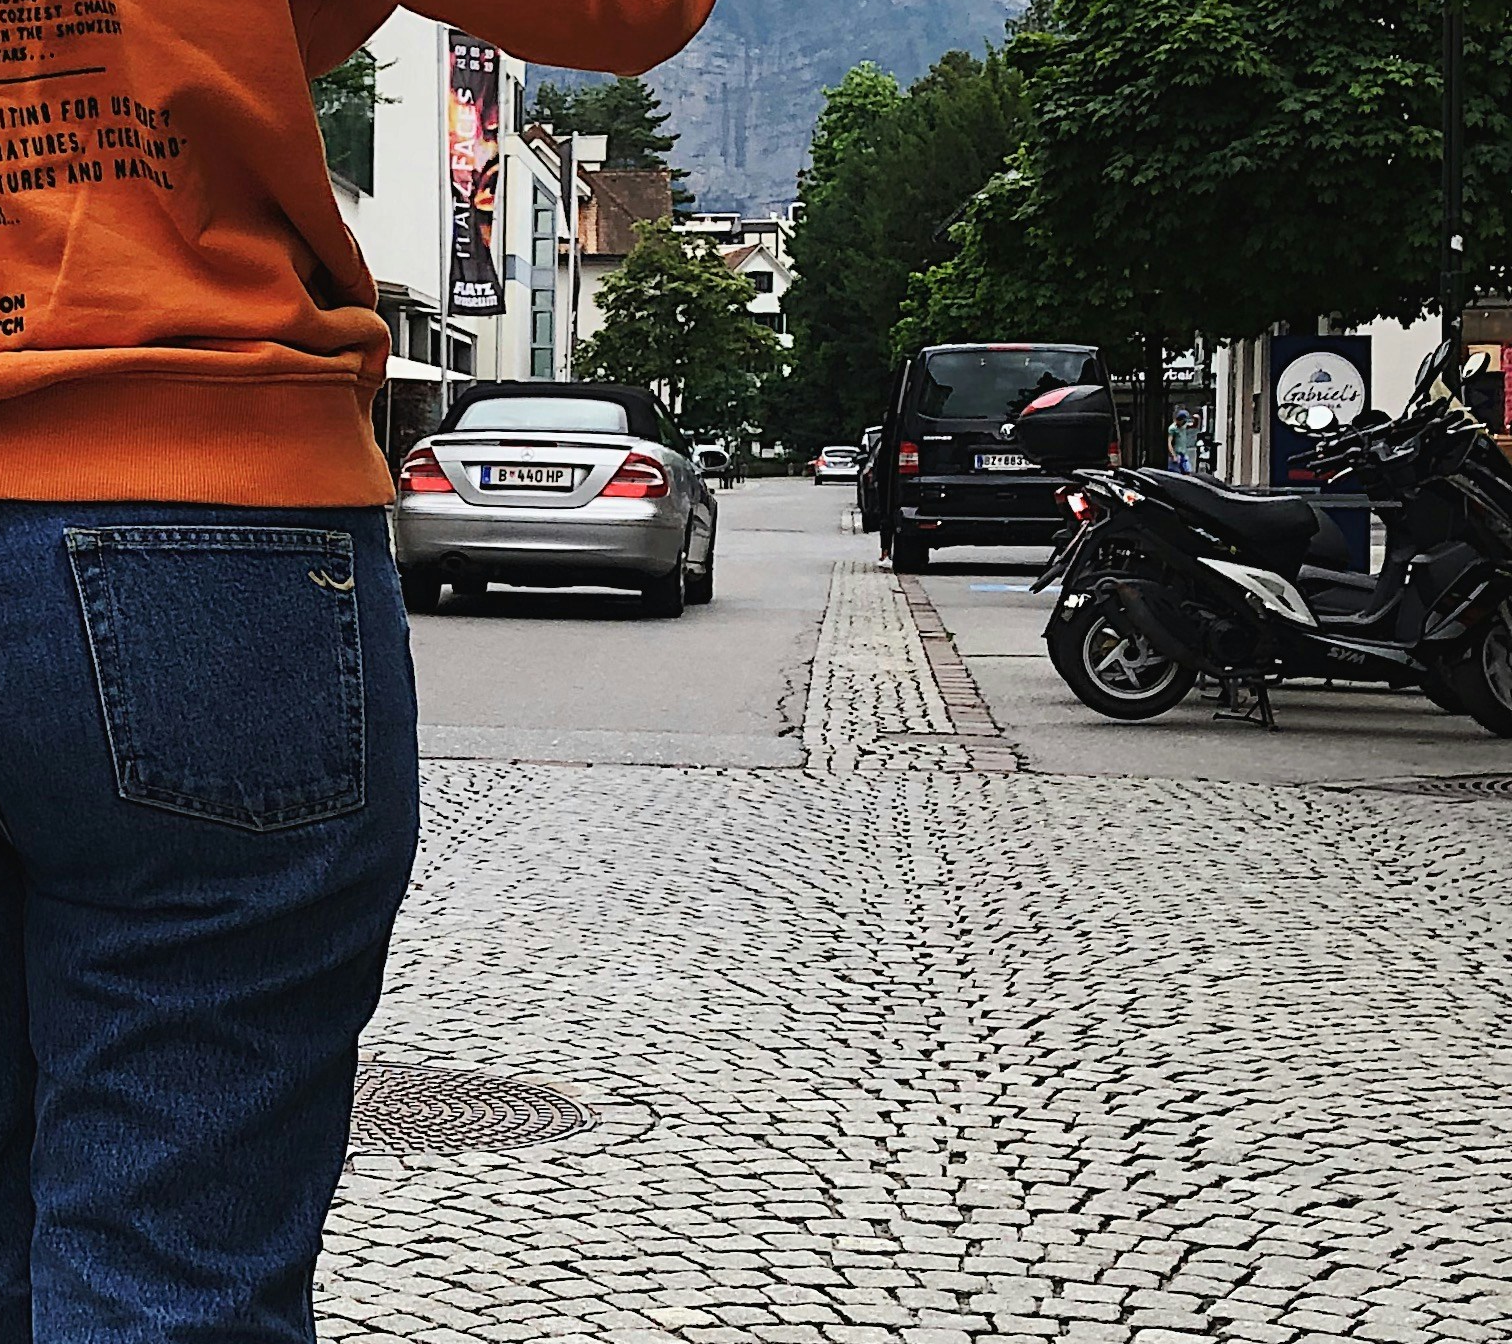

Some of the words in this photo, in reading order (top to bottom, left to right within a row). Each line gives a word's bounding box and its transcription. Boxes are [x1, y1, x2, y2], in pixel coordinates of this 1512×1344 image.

[16, 25, 43, 41] THE
[60, 95, 100, 122] FOR
[110, 95, 131, 117] US
[67, 160, 103, 184] AND
[1283, 383, 1361, 402] Gabriel's
[498, 469, 507, 482] B
